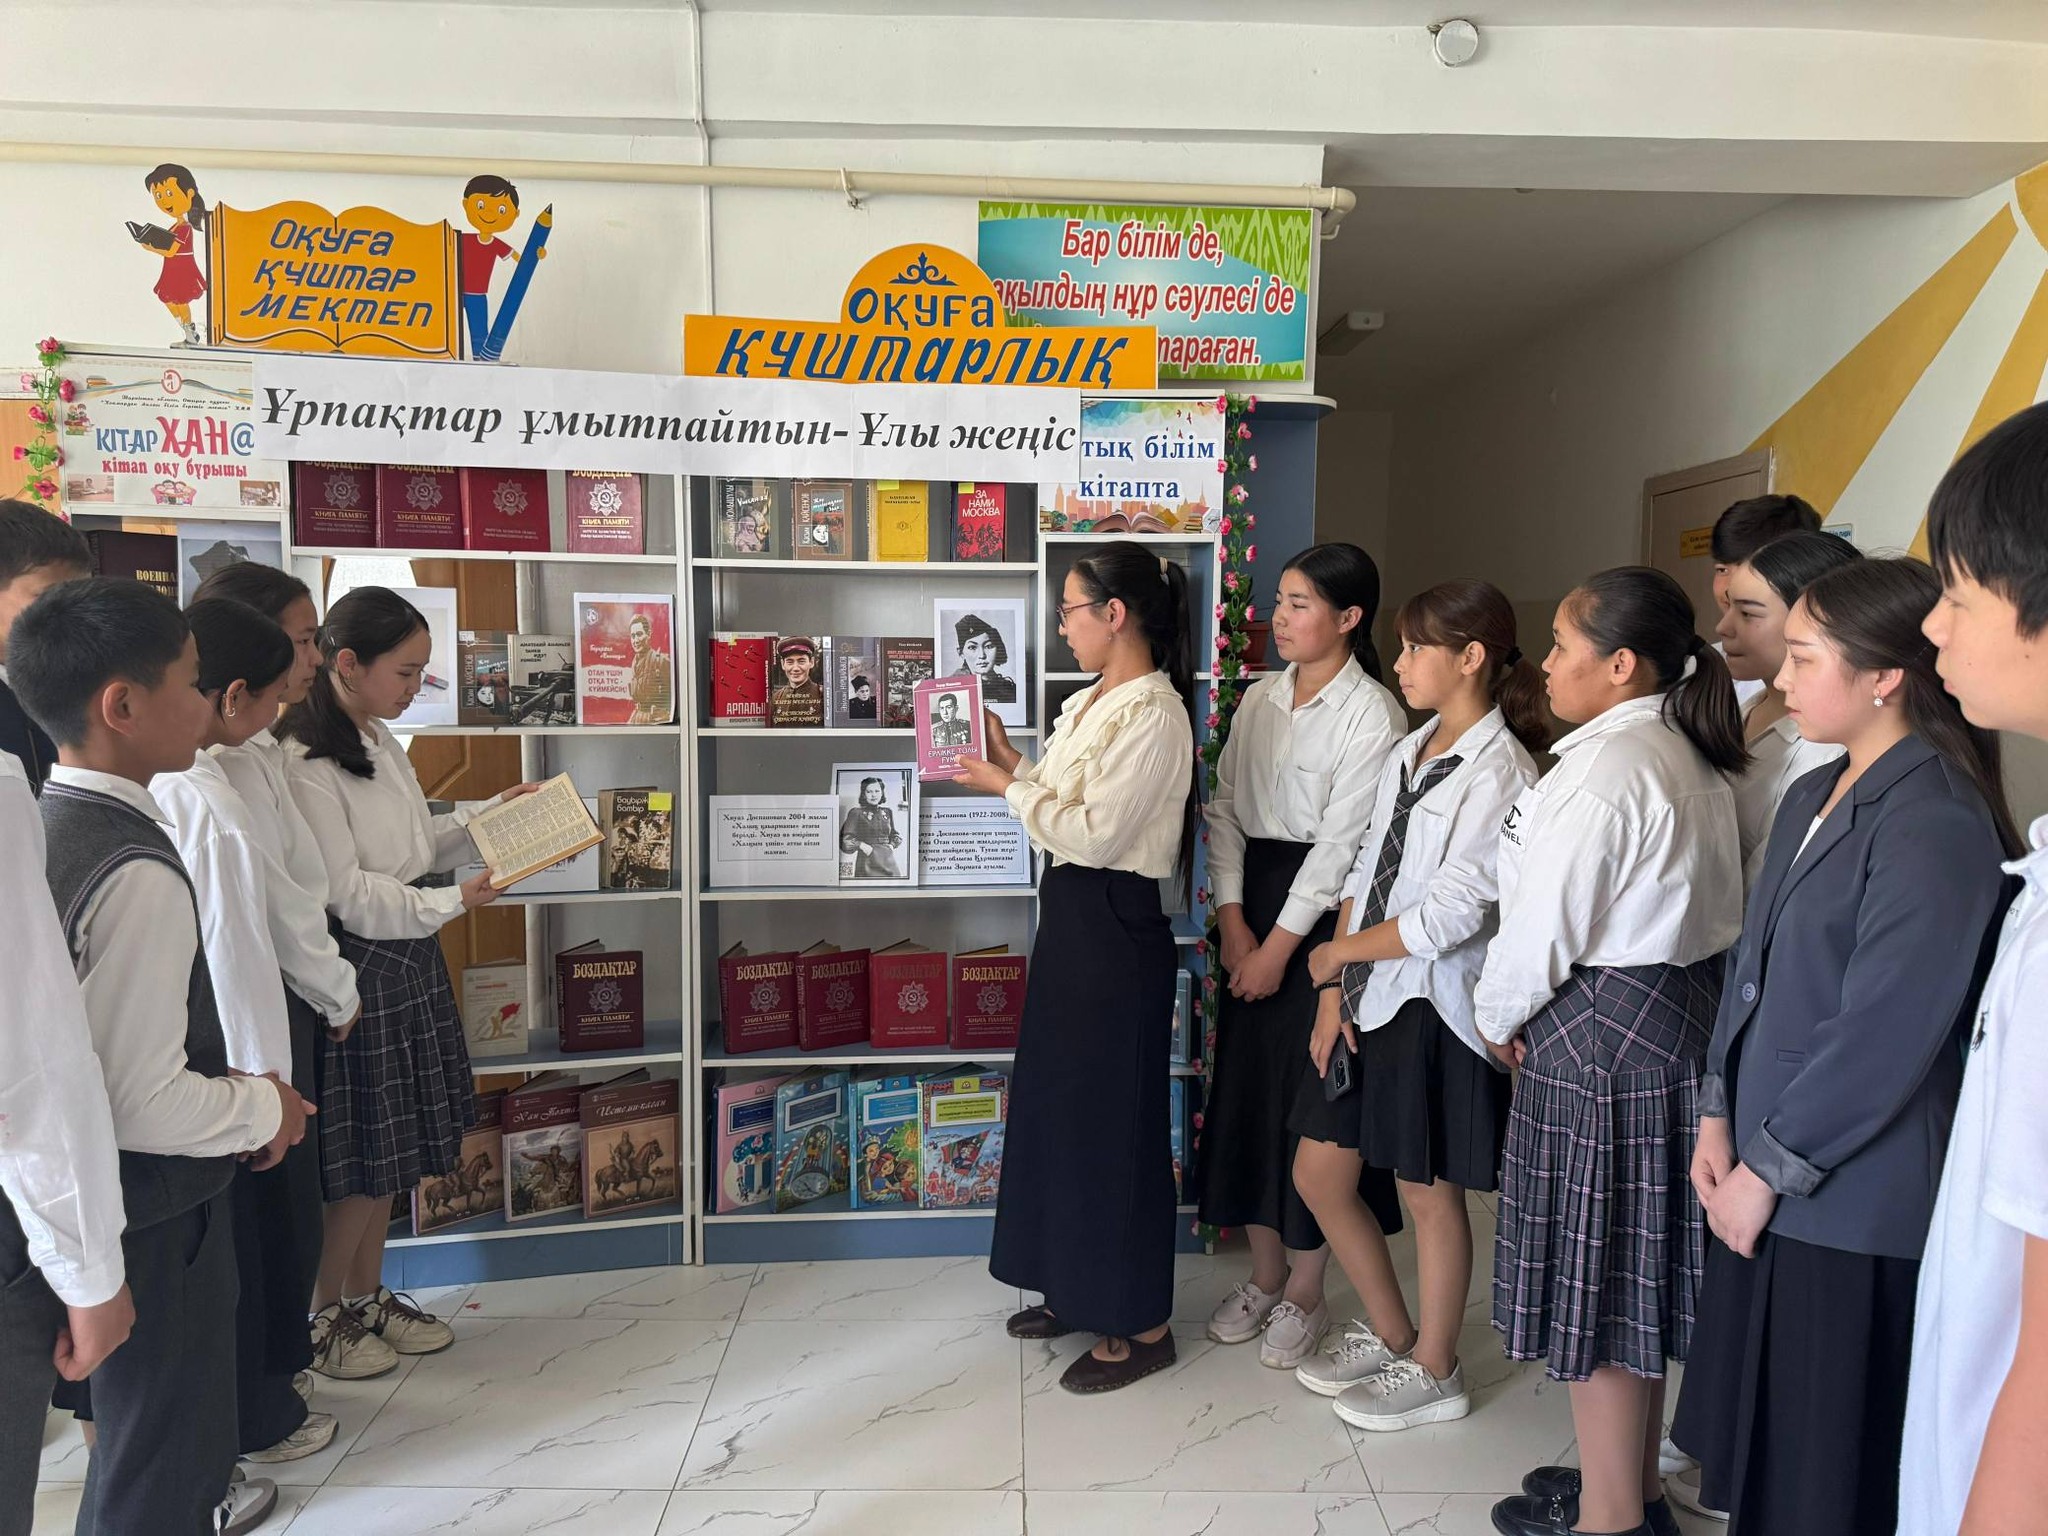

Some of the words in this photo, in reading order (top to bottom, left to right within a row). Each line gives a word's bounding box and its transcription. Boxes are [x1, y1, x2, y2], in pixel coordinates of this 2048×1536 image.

[1062, 220, 1110, 266] Бар
[1117, 220, 1181, 259] білім
[1188, 223, 1223, 266] де,
[993, 273, 1106, 317] ақылдың
[1113, 284, 1157, 319] нұр
[1165, 277, 1259, 321] сәулесі
[1264, 277, 1296, 313] де
[261, 387, 502, 443] Ұрпақтар
[858, 412, 940, 449] Ұлы
[949, 416, 1077, 458] жеңіс
[1081, 440, 1134, 461] тық
[1144, 434, 1215, 459] білім
[102, 456, 148, 474] кітап
[154, 461, 180, 480] оқу
[975, 490, 987, 499] ЗА
[1080, 473, 1180, 498] кітапта
[962, 507, 1000, 518] МОСКВА
[968, 498, 995, 508] НАМИ
[314, 510, 337, 518] КНИГА
[338, 511, 368, 519] ПАМЯТИ
[397, 513, 419, 521] КНИГА
[420, 514, 451, 522] ПАМЯТИ
[603, 518, 630, 526] ПАМЯТИ
[136, 569, 175, 582] ВОЕННА
[727, 702, 765, 715] АРПАЛЫ
[1500, 823, 1522, 846] ANEL
[572, 960, 637, 979] БОЗДАҚТАР
[736, 961, 795, 981] БОЗДАҚТАР
[811, 960, 866, 979] БОЗДАҚТАР
[962, 966, 1021, 982] БОЗДАҚТАР
